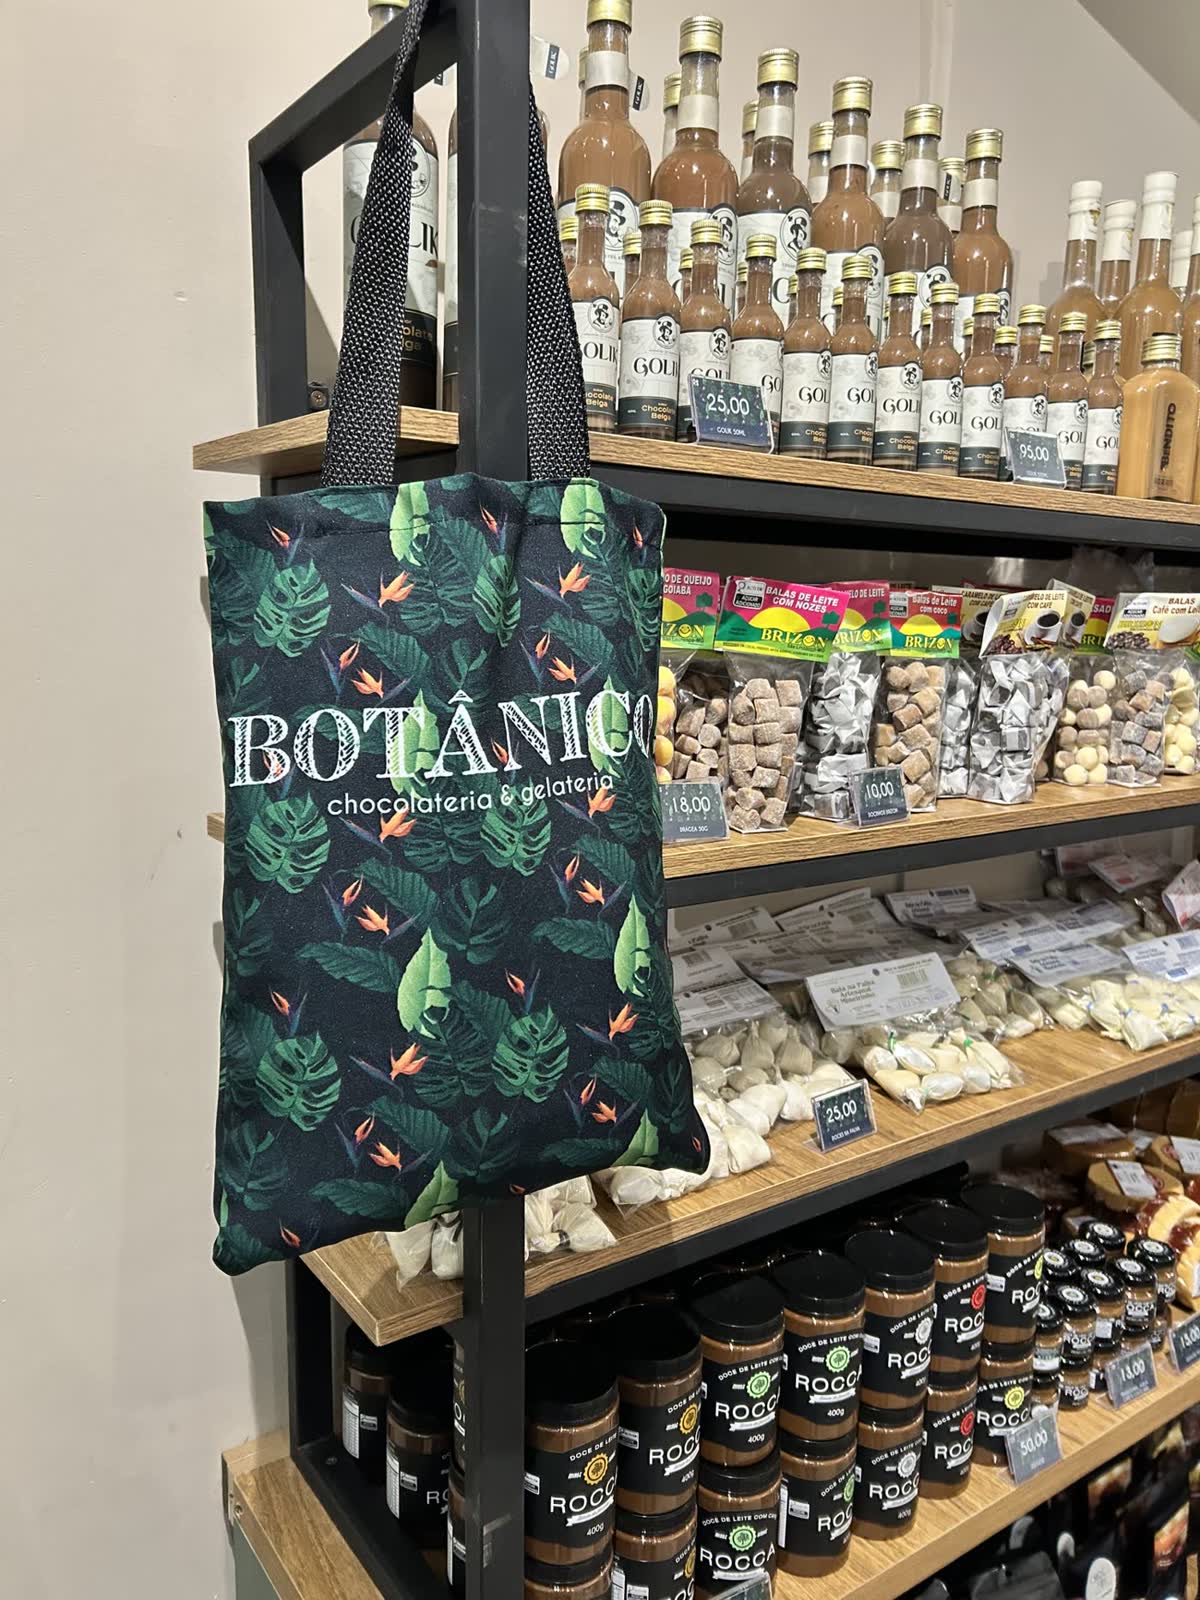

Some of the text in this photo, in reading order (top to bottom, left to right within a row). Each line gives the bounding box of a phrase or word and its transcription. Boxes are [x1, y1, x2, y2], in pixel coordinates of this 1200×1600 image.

[706, 393, 751, 416] 25,00
[1019, 443, 1050, 462] 95,00
[671, 574, 682, 584] DE
[683, 575, 713, 586] QUEIJO
[663, 585, 692, 595] GOIABA
[765, 585, 796, 599] BALAS
[798, 592, 812, 602] DE
[813, 594, 840, 607] LEITE
[859, 589, 868, 598] DE
[868, 587, 886, 598] LEITE
[772, 596, 827, 614] COM NOZES
[930, 596, 940, 605] de
[941, 596, 958, 607] Leite
[1152, 604, 1169, 615] Café
[1170, 607, 1187, 615] com
[1167, 597, 1197, 605] BALAS
[933, 605, 948, 615] coco
[761, 627, 827, 648] BRIZON
[905, 634, 955, 650] BRIZON
[228, 689, 655, 788] BOTÂNICO
[327, 771, 614, 816] chocolateria & gelateria
[865, 781, 895, 800] 10,00
[672, 796, 711, 814] 18,00
[825, 1099, 857, 1124] 25,00
[797, 1341, 817, 1353] DOCE
[829, 1335, 848, 1345] LEITE
[718, 1368, 738, 1381] DOCE
[738, 1365, 750, 1374] DE
[750, 1360, 768, 1370] LEITE
[667, 1398, 688, 1414] DOCE
[827, 1408, 845, 1417] 400g
[747, 1433, 766, 1444] 400g
[569, 1447, 593, 1462] DOCE
[594, 1441, 604, 1451] DE
[820, 1481, 838, 1498] DOCE
[702, 1516, 720, 1527] DOCE
[720, 1515, 732, 1523] DE
[732, 1514, 753, 1523] LEITE
[586, 1522, 605, 1537] 400g
[700, 1541, 776, 1571] ROCCA
